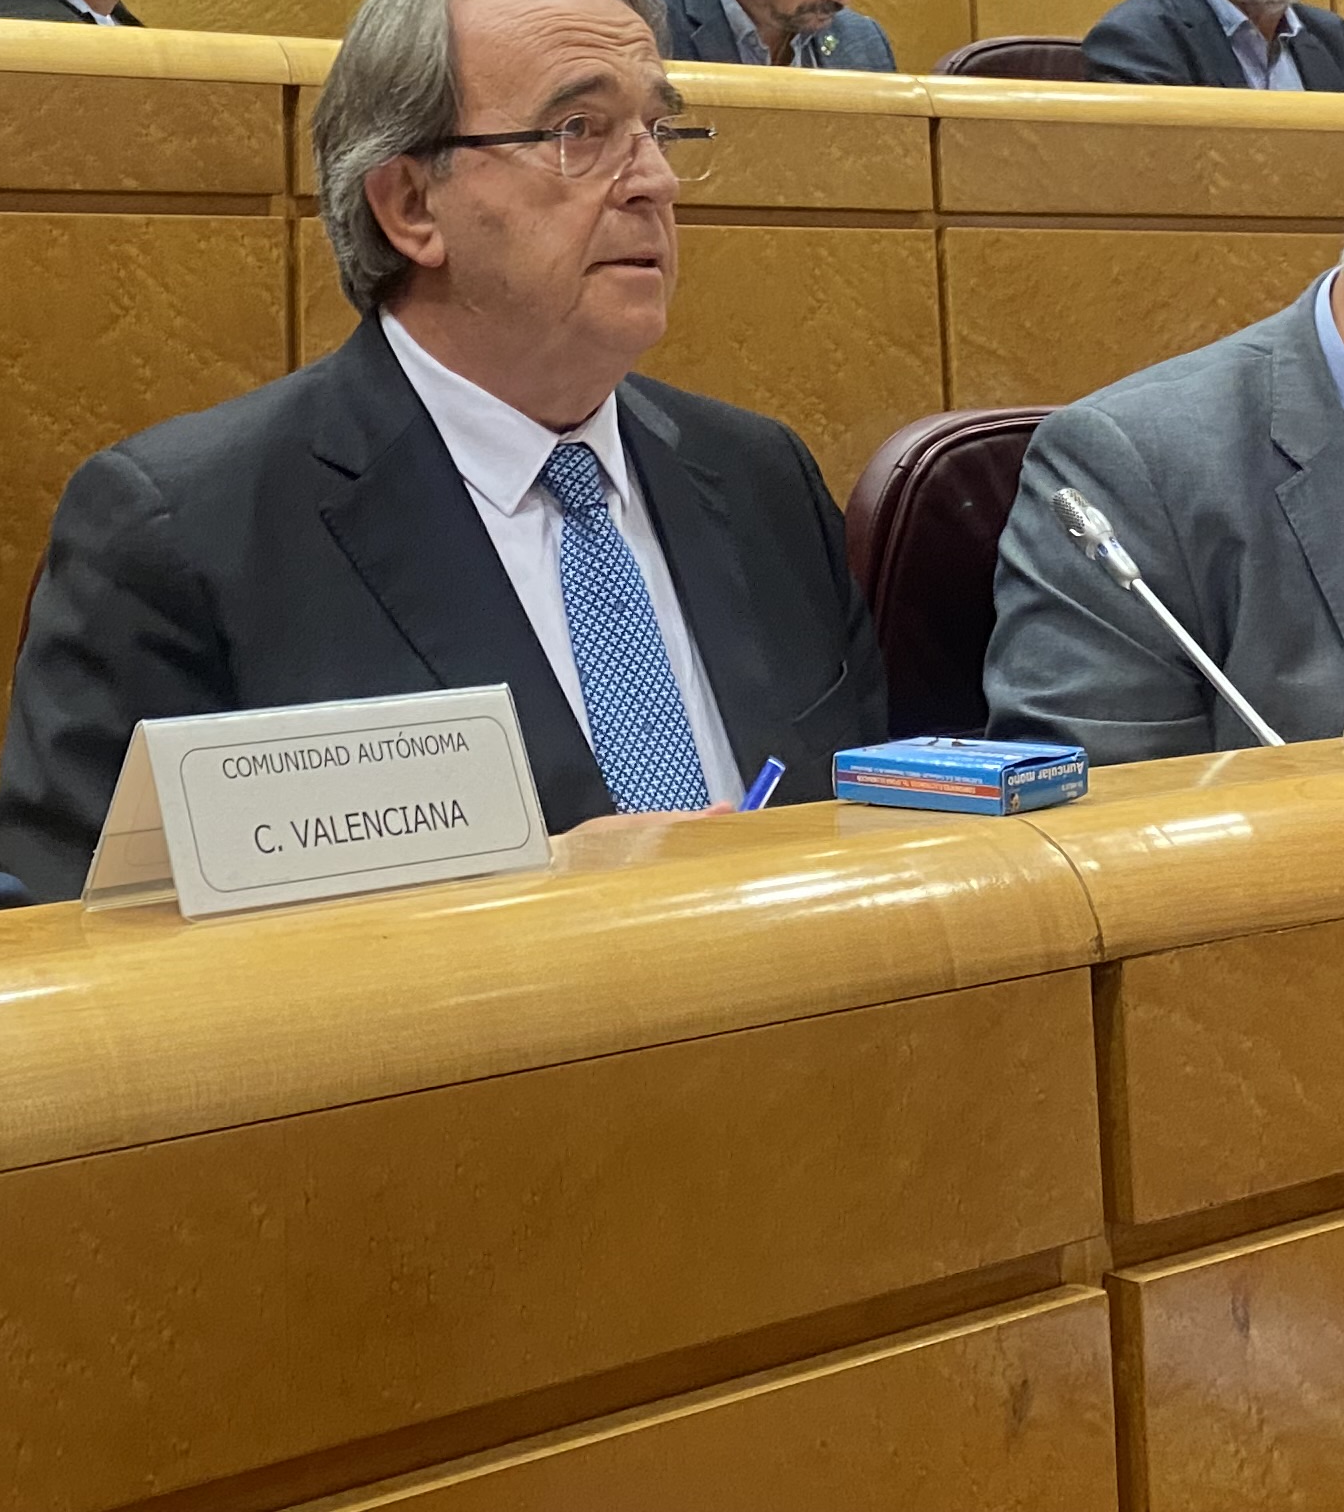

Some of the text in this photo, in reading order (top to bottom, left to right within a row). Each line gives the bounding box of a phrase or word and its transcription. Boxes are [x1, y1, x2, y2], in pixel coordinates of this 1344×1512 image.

[222, 731, 469, 779] COMUNIDAD AUTÓNOMA
[1008, 760, 1085, 786] Auricular mono
[254, 799, 469, 854] C. VALENCIANA
